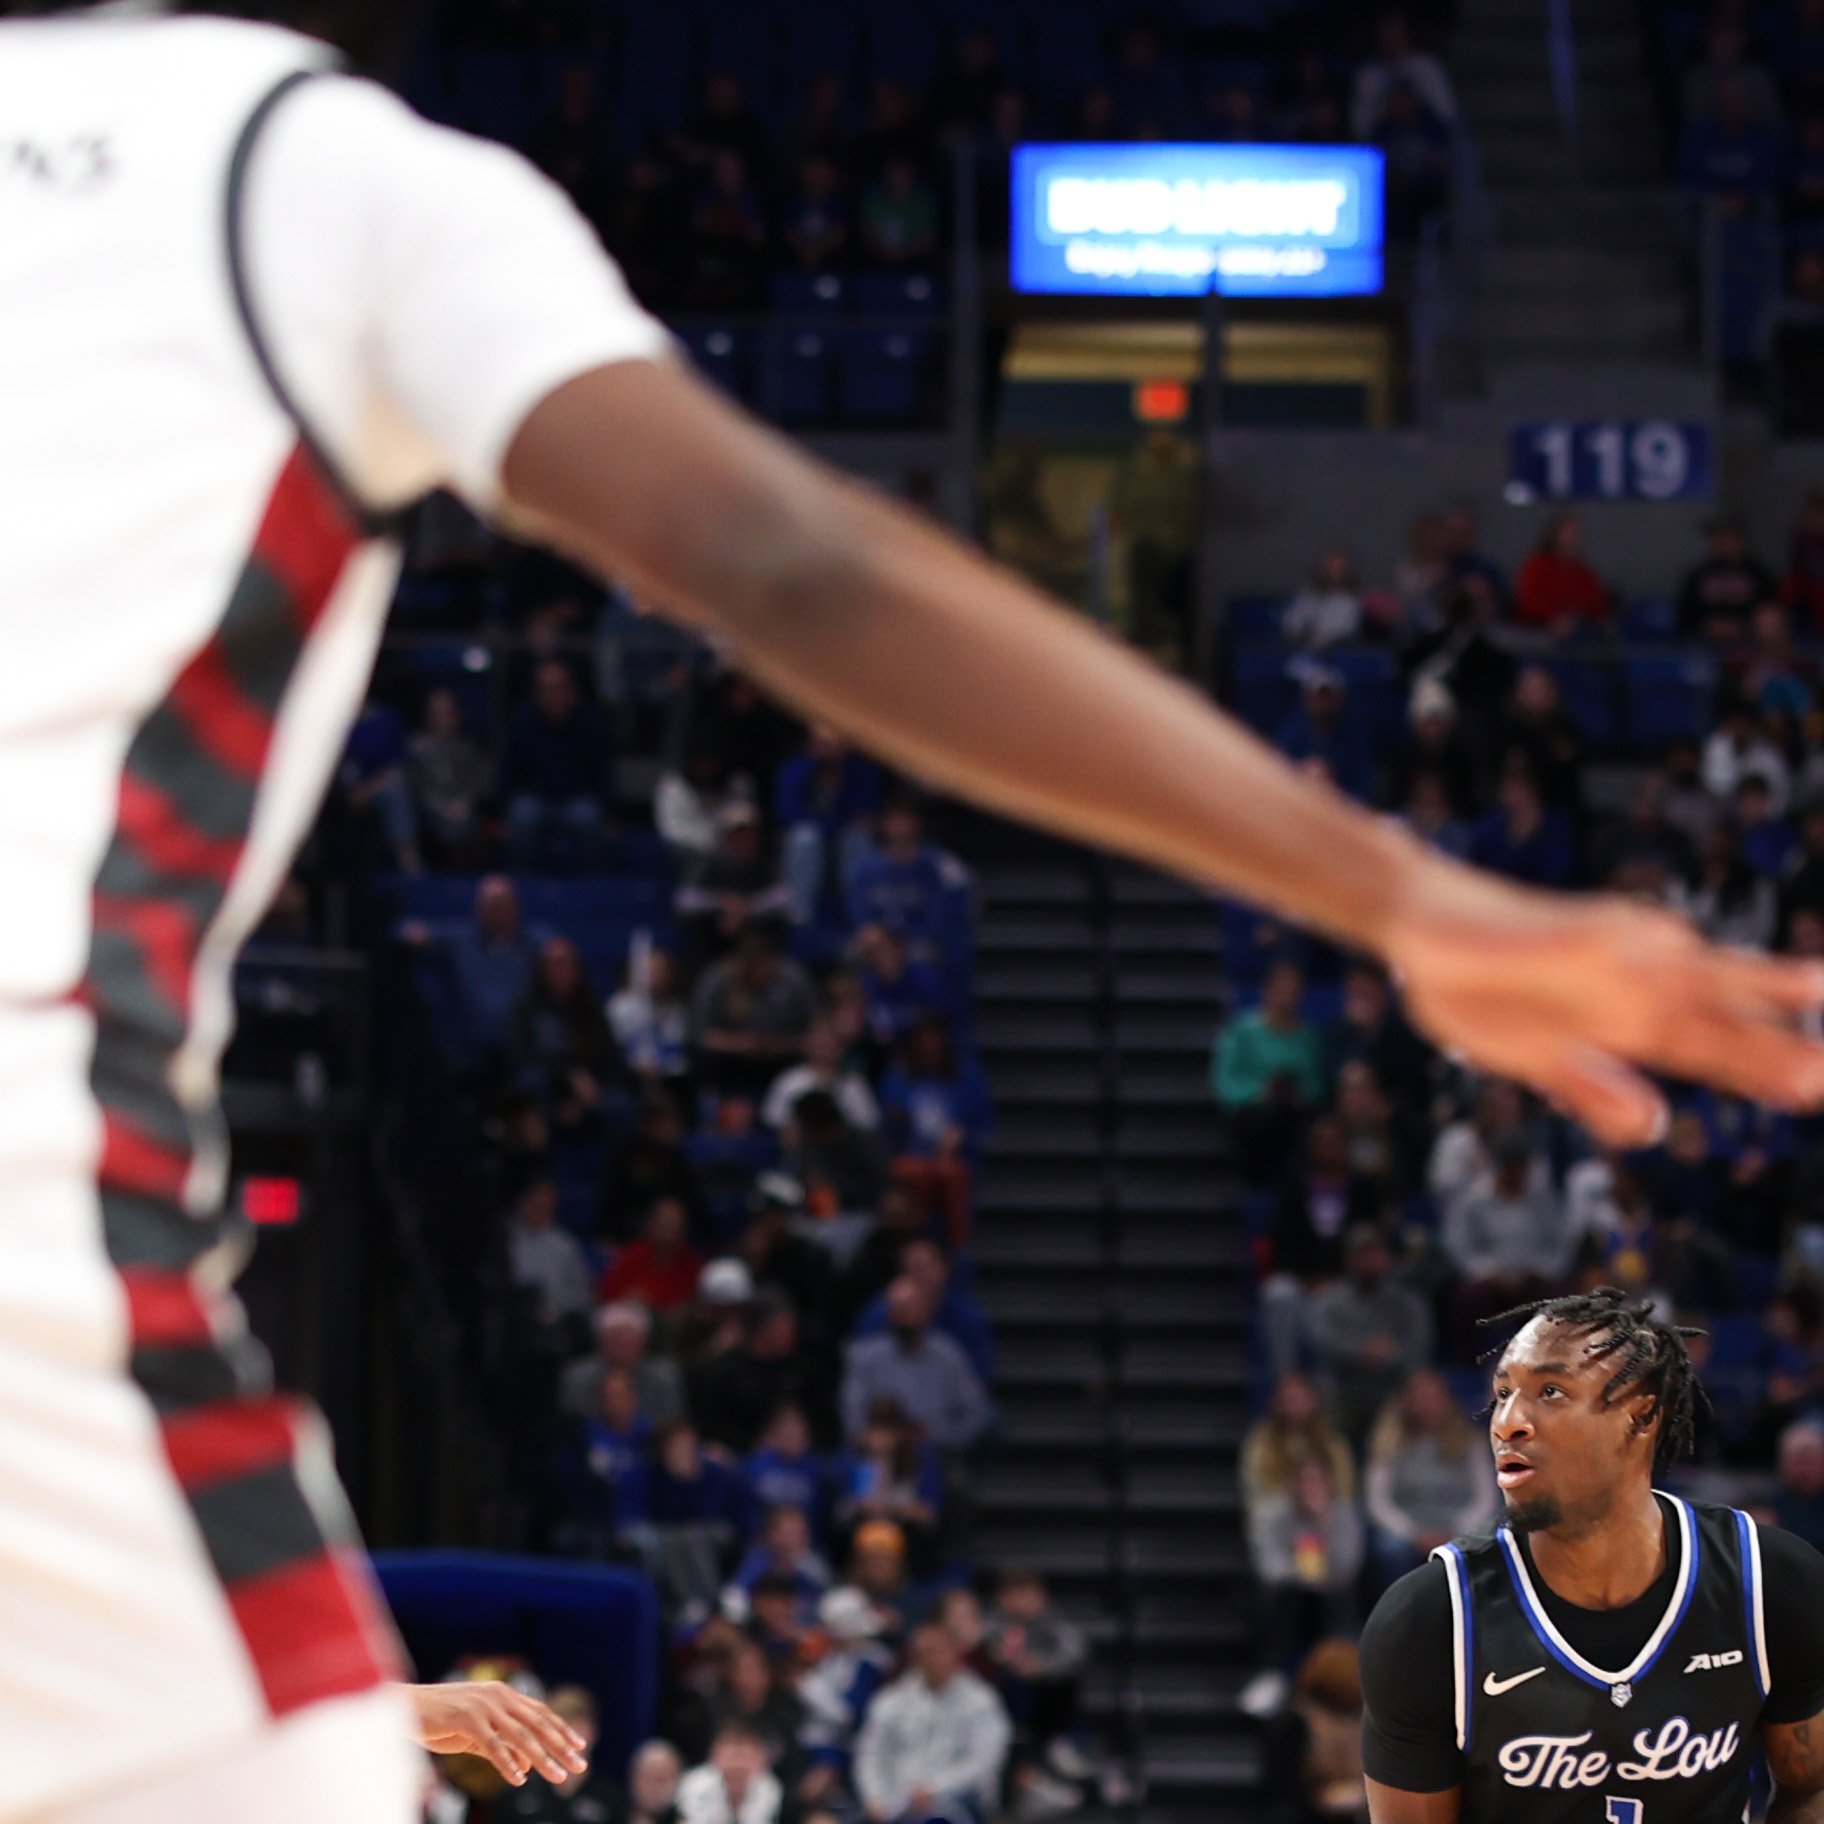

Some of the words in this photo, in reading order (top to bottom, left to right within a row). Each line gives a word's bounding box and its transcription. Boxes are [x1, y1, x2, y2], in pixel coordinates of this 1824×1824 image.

[1533, 421, 1689, 498] 119
[1498, 1728, 1611, 1790] The
[1616, 1714, 1740, 1781] Lou
